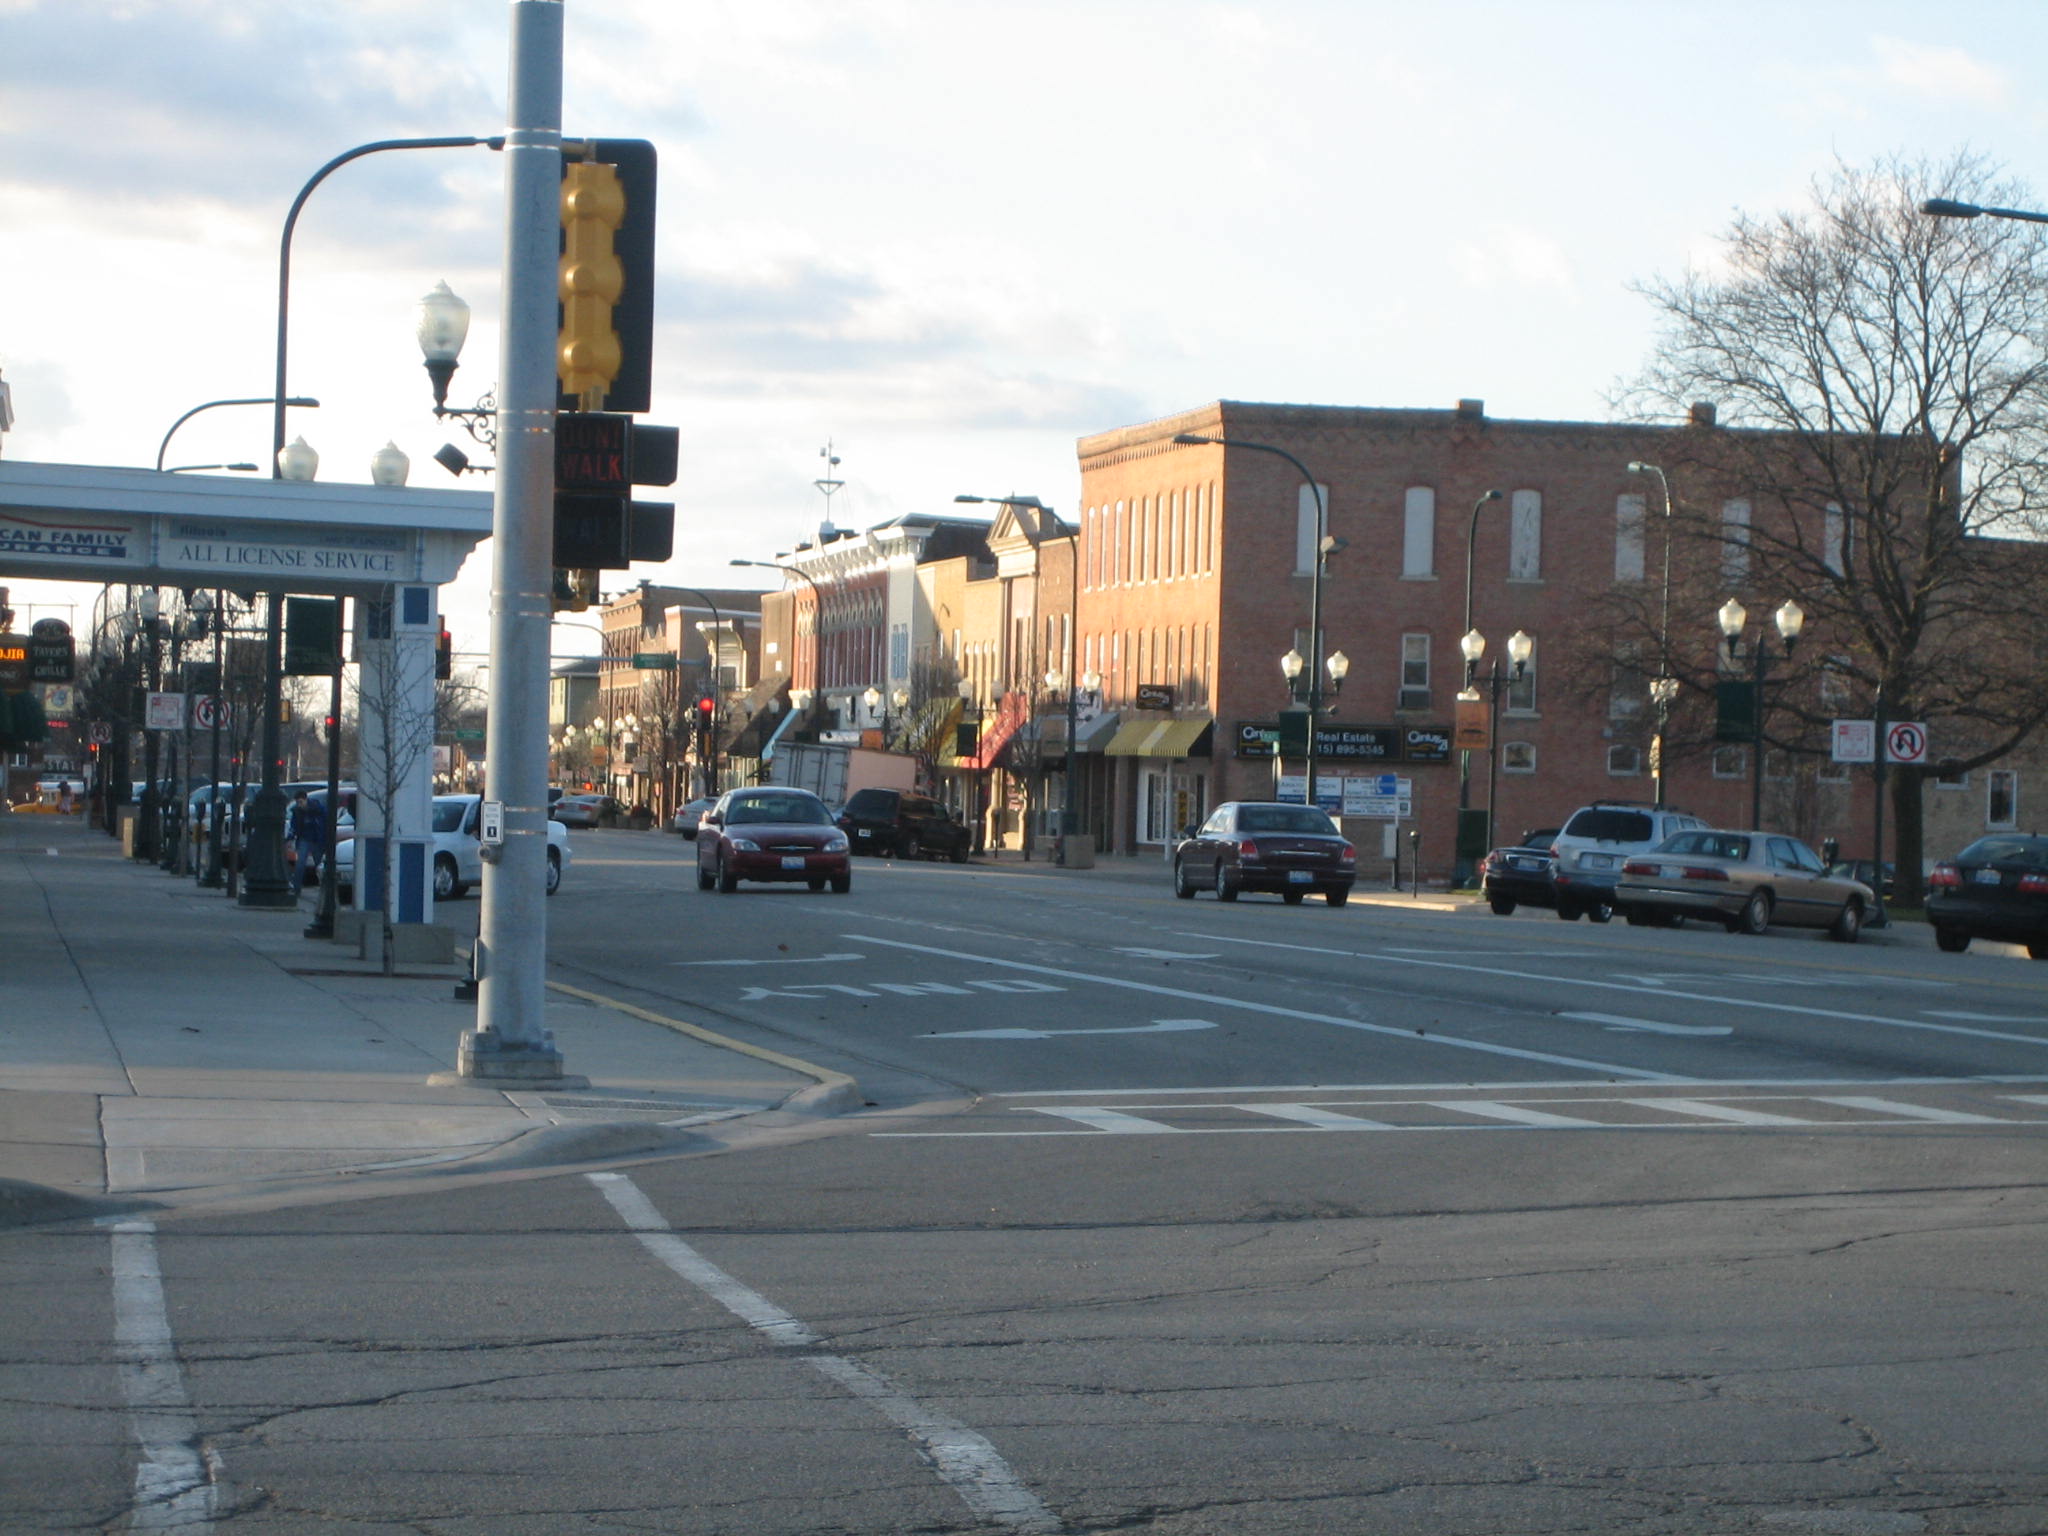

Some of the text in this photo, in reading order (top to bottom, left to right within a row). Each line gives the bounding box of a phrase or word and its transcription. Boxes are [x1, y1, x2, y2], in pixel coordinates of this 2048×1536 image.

[561, 452, 623, 481] WALK
[51, 531, 126, 546] FAMILY
[179, 545, 395, 571] ALL LICENSE SERVICE
[1316, 731, 1376, 743] Real Estate
